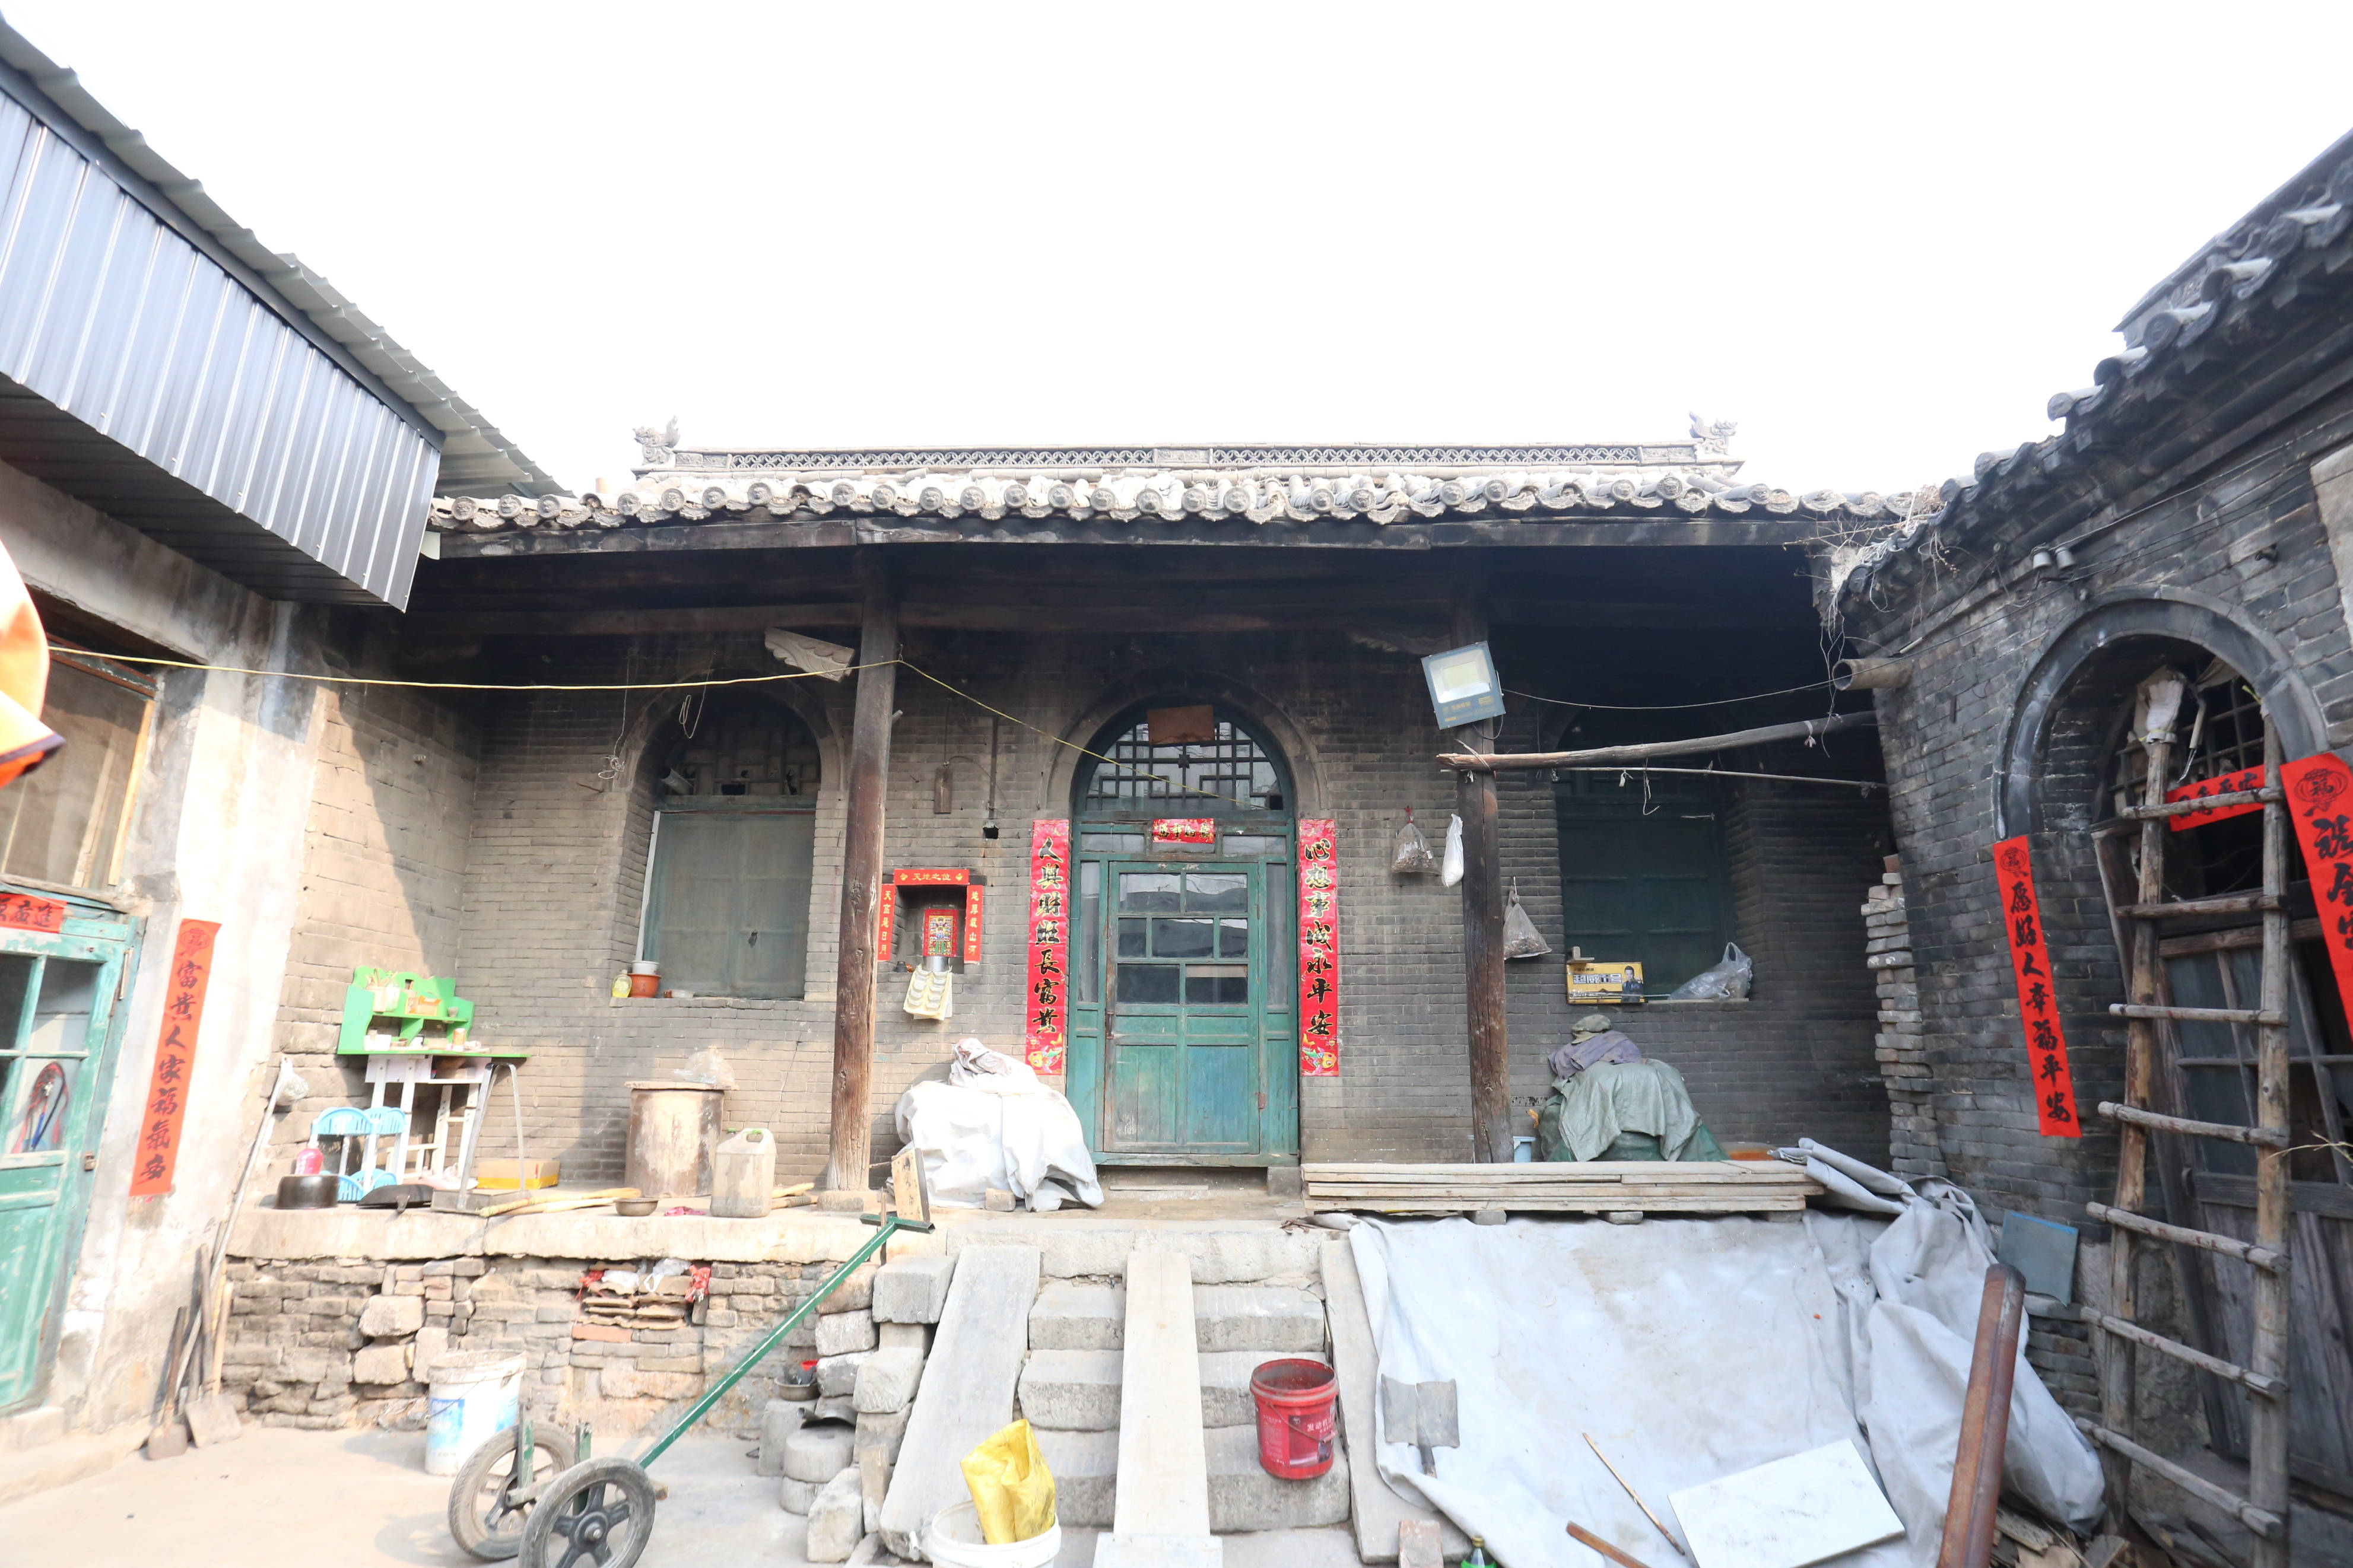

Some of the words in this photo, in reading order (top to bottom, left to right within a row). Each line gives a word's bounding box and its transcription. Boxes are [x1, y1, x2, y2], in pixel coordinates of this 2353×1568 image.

[1304, 838, 1333, 1036] 心想事成永平安
